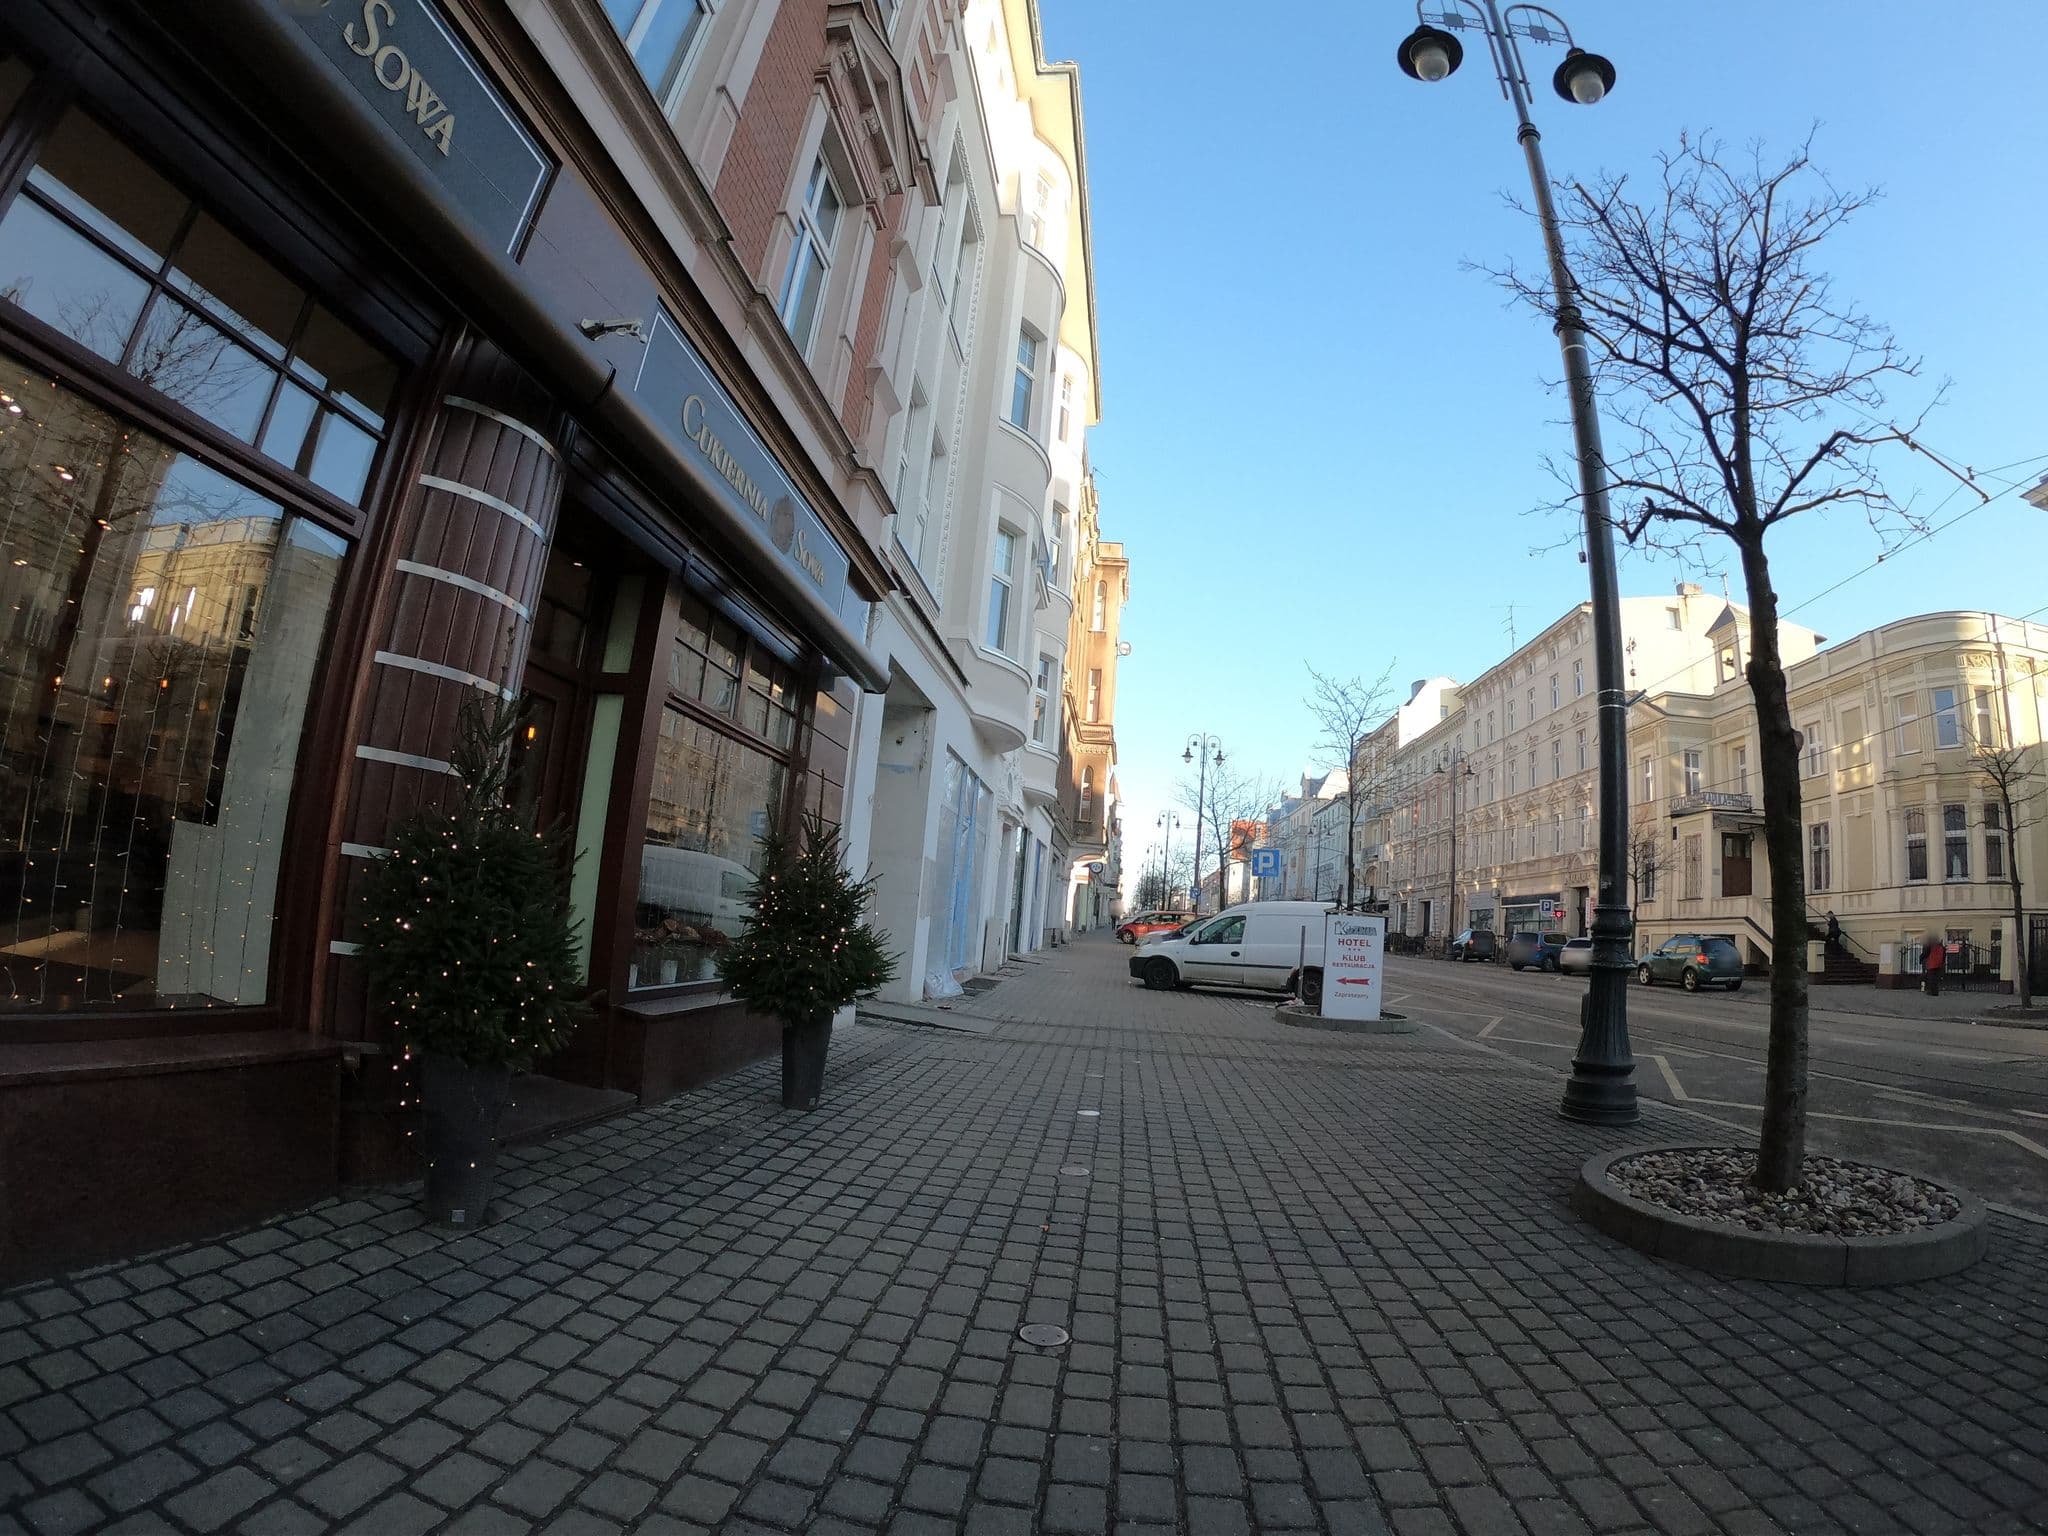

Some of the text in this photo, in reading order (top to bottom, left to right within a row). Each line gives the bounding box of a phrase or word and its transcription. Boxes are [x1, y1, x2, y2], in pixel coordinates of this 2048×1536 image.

[343, 0, 455, 157] SOWA
[683, 394, 825, 586] CUKIERNIA SOWA
[1258, 851, 1274, 874] P
[1338, 938, 1371, 947] HOTEL
[1342, 954, 1366, 962] KLUB
